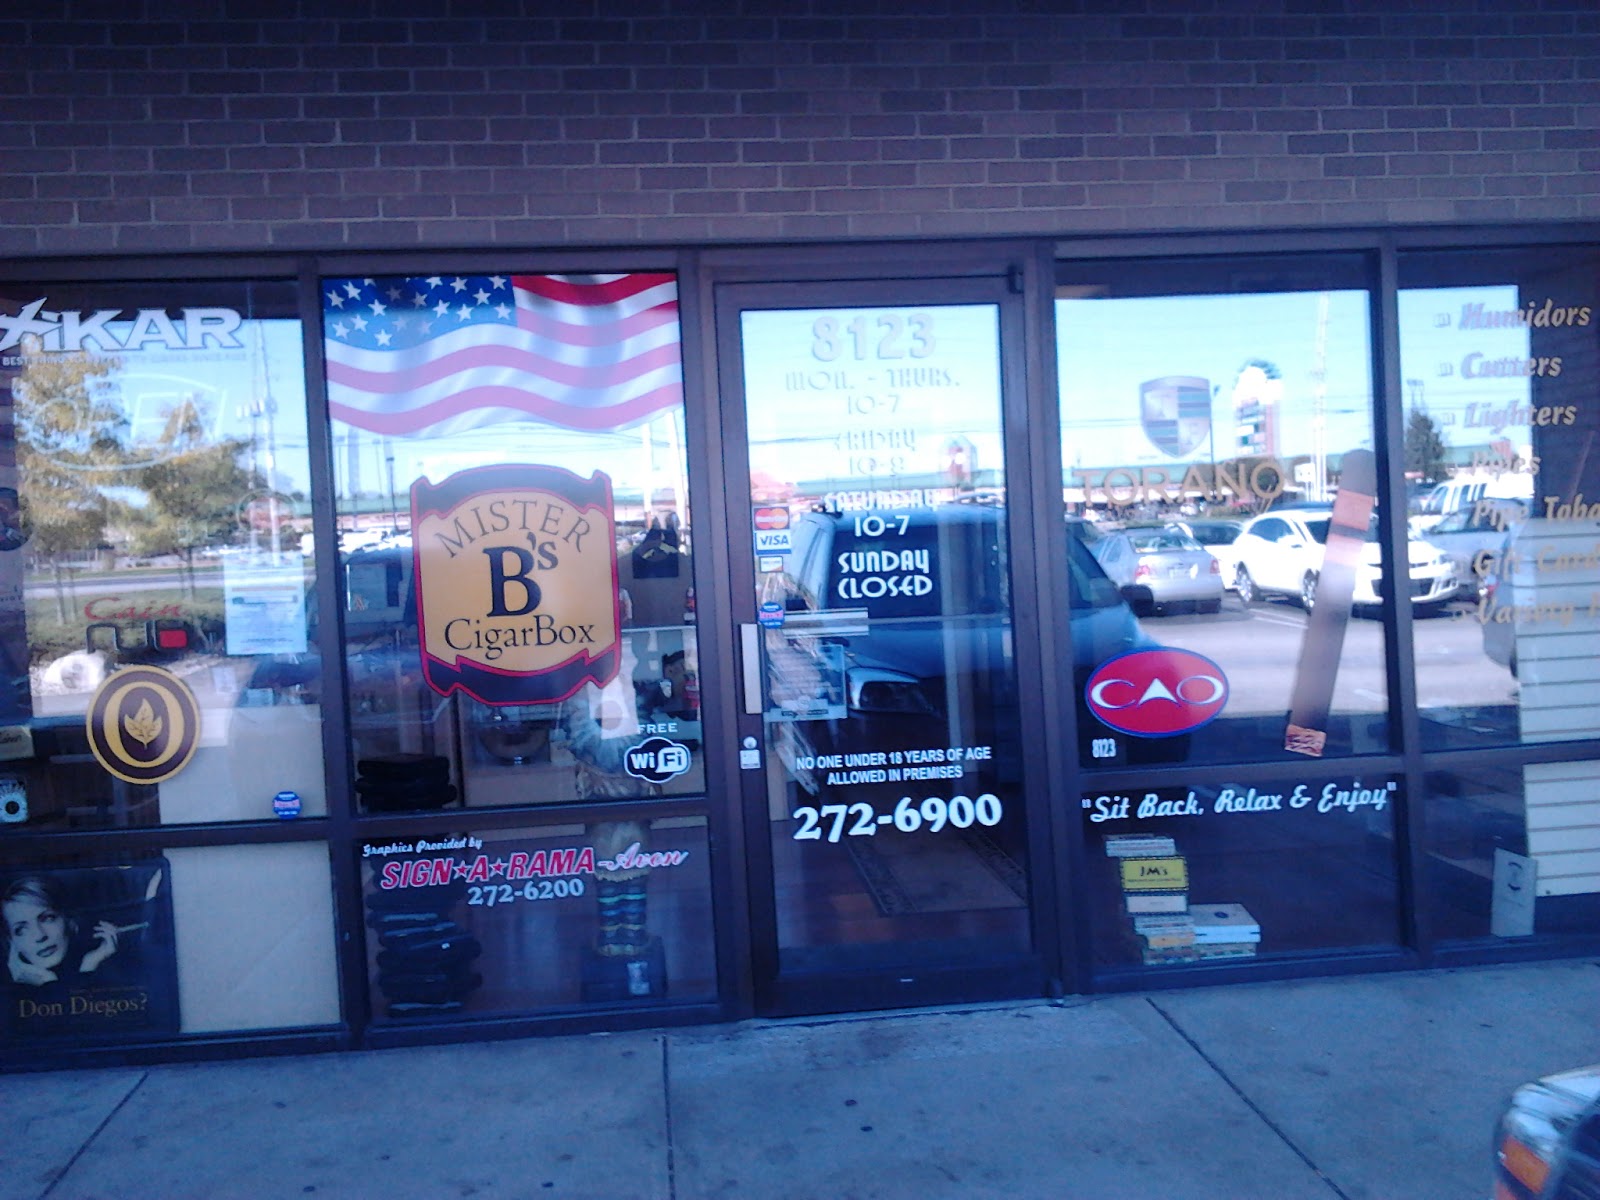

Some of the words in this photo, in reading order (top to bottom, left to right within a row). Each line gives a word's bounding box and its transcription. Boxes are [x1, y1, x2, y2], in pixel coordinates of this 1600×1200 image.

[1458, 298, 1593, 331] Humidors
[811, 313, 935, 362] 8123
[1460, 351, 1563, 379] Cutters
[847, 395, 900, 415] 10-7
[1464, 397, 1577, 435] Lighters
[1072, 461, 1285, 509] TORANO
[434, 499, 591, 558] MISTER
[854, 515, 911, 537] 10-7
[760, 535, 790, 546] VISA
[837, 549, 930, 574] SUNDAY
[837, 574, 933, 599] CLOSED
[1091, 675, 1225, 709] CAO
[638, 722, 678, 733] FREE
[796, 757, 815, 770] NO
[817, 755, 843, 769] ONE
[845, 752, 888, 767] UNDER
[889, 751, 903, 765] 18
[904, 749, 945, 764] YEARS
[946, 748, 963, 761] OF
[964, 746, 992, 760] AGE
[827, 770, 887, 785] ALLOWED
[888, 769, 902, 782] IN
[903, 765, 964, 780] PREMISES
[1214, 788, 1282, 814] Relax
[1290, 785, 1311, 808] &
[792, 794, 1002, 843] 272-6900
[362, 842, 414, 858] Graphics
[416, 838, 468, 854] Provided
[468, 837, 482, 850] by
[467, 878, 585, 907] 272-6200
[19, 998, 62, 1018] Don
[70, 993, 148, 1016] Diegos?
